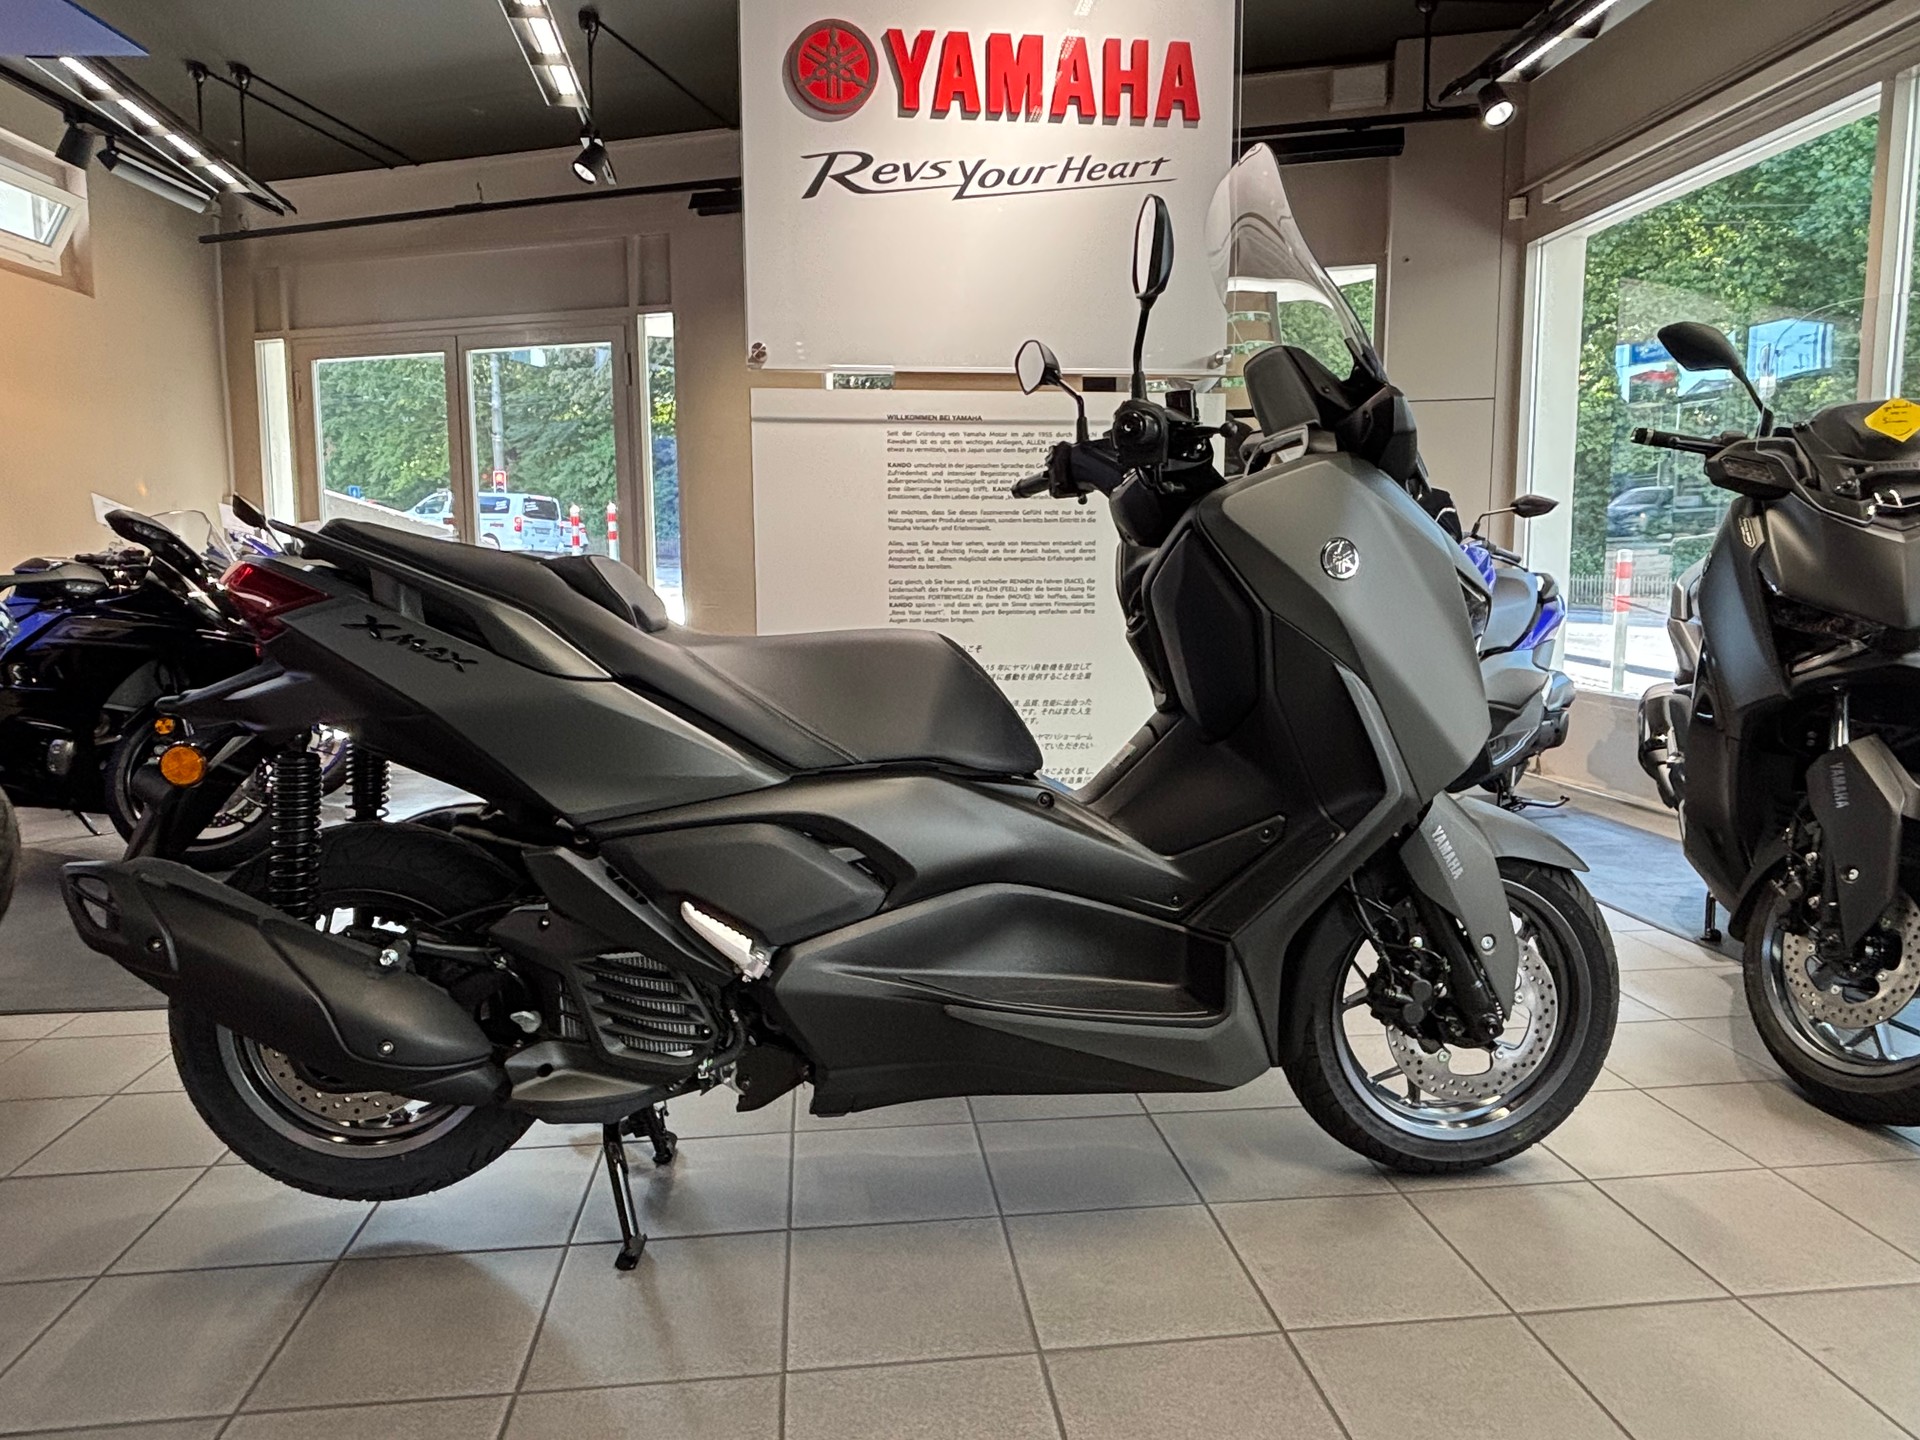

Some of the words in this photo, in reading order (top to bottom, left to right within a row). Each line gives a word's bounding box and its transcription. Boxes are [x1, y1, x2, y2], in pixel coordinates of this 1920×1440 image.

[882, 29, 1200, 126] YAMAHA
[801, 151, 953, 199] Revs
[953, 158, 1057, 200] Your
[1058, 155, 1171, 185] Heart
[1828, 762, 1850, 808] YAMAHA
[1432, 825, 1464, 880] YAMAHA
